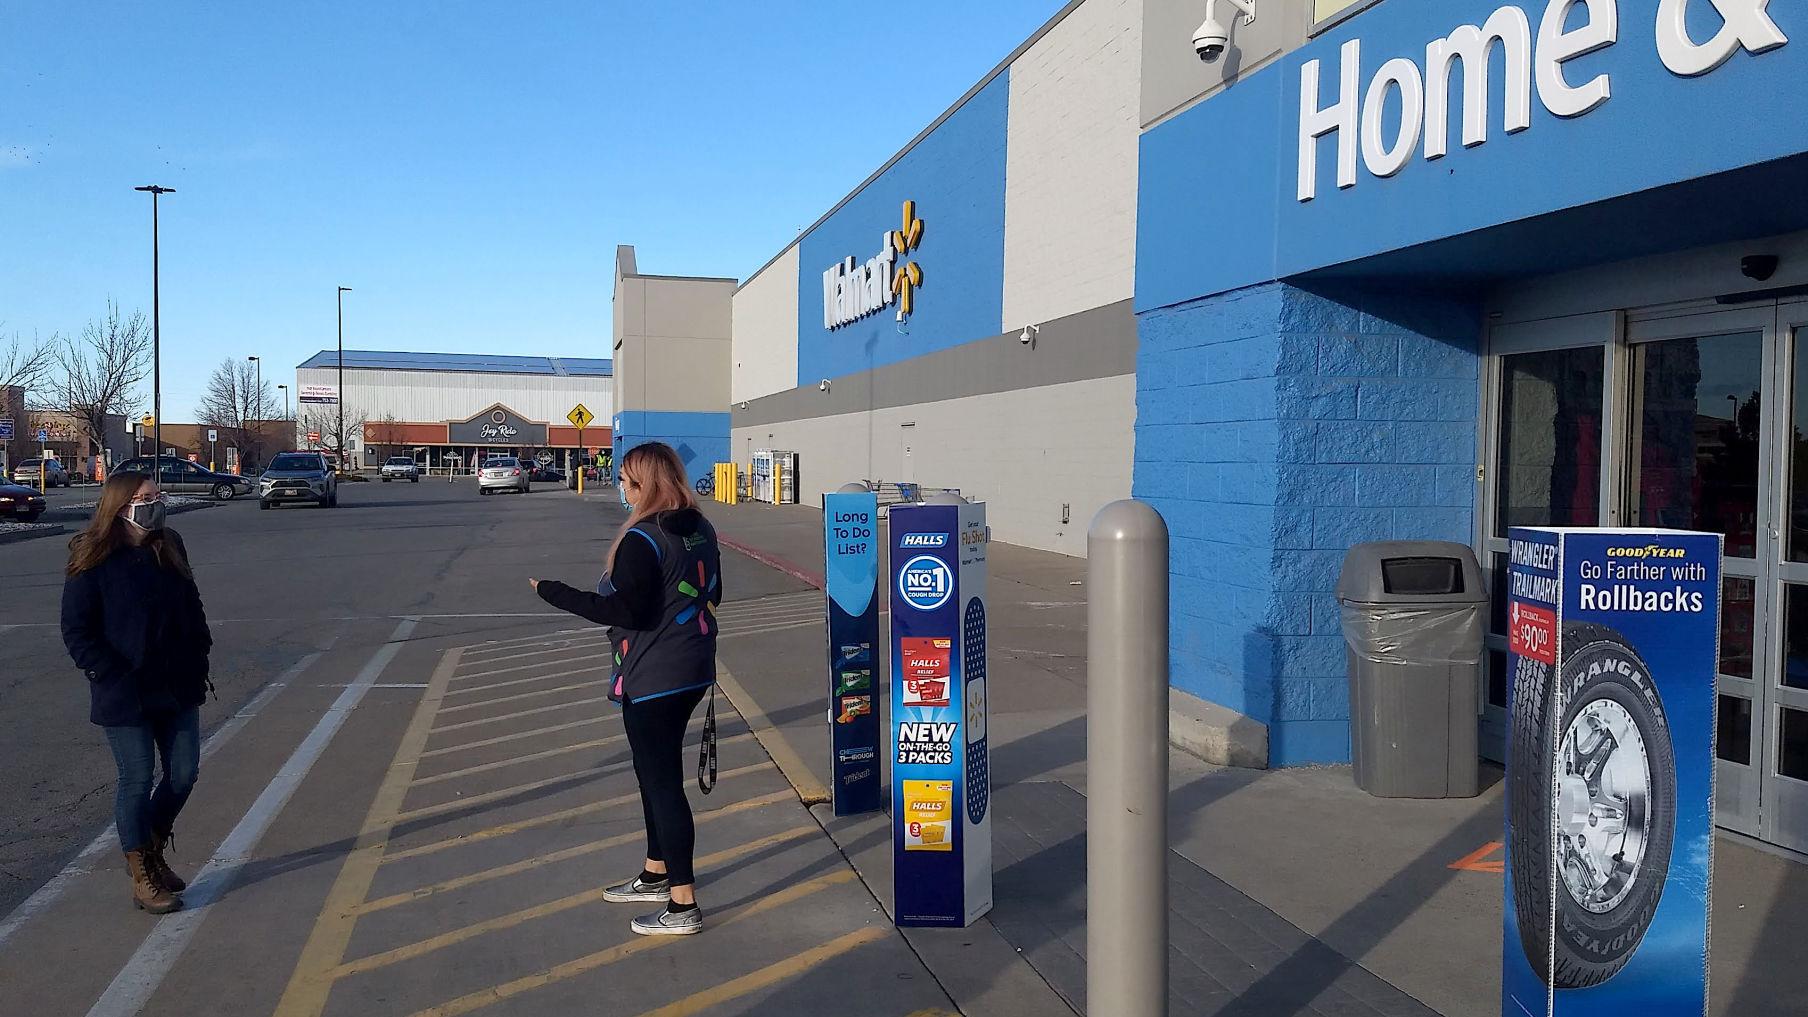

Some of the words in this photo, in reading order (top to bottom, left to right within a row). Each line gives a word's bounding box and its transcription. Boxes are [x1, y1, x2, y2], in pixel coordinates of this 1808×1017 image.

[1297, 0, 1617, 201] Home
[823, 231, 893, 329] Walmart
[481, 424, 497, 438] Joy
[498, 425, 517, 437] Ride
[835, 511, 868, 524] Long
[833, 528, 848, 538] To
[853, 527, 870, 538] Do
[905, 536, 943, 545] HALLS
[838, 543, 867, 555] List?
[1607, 545, 1685, 558] GOODYEAR
[1580, 561, 1600, 579] Go
[1608, 562, 1666, 580] Farther
[1672, 563, 1705, 581] with
[1513, 572, 1558, 604] TRAILMARK
[1580, 584, 1703, 612] Rollbacks
[844, 673, 864, 683] Trident
[910, 681, 917, 690] 3
[845, 700, 865, 709] Trident
[899, 723, 957, 741] NEW
[899, 743, 950, 751] ON-THE-GO
[899, 752, 906, 763] 3
[908, 752, 952, 763] PACKS
[844, 769, 870, 784] Trident
[912, 824, 919, 832] 3
